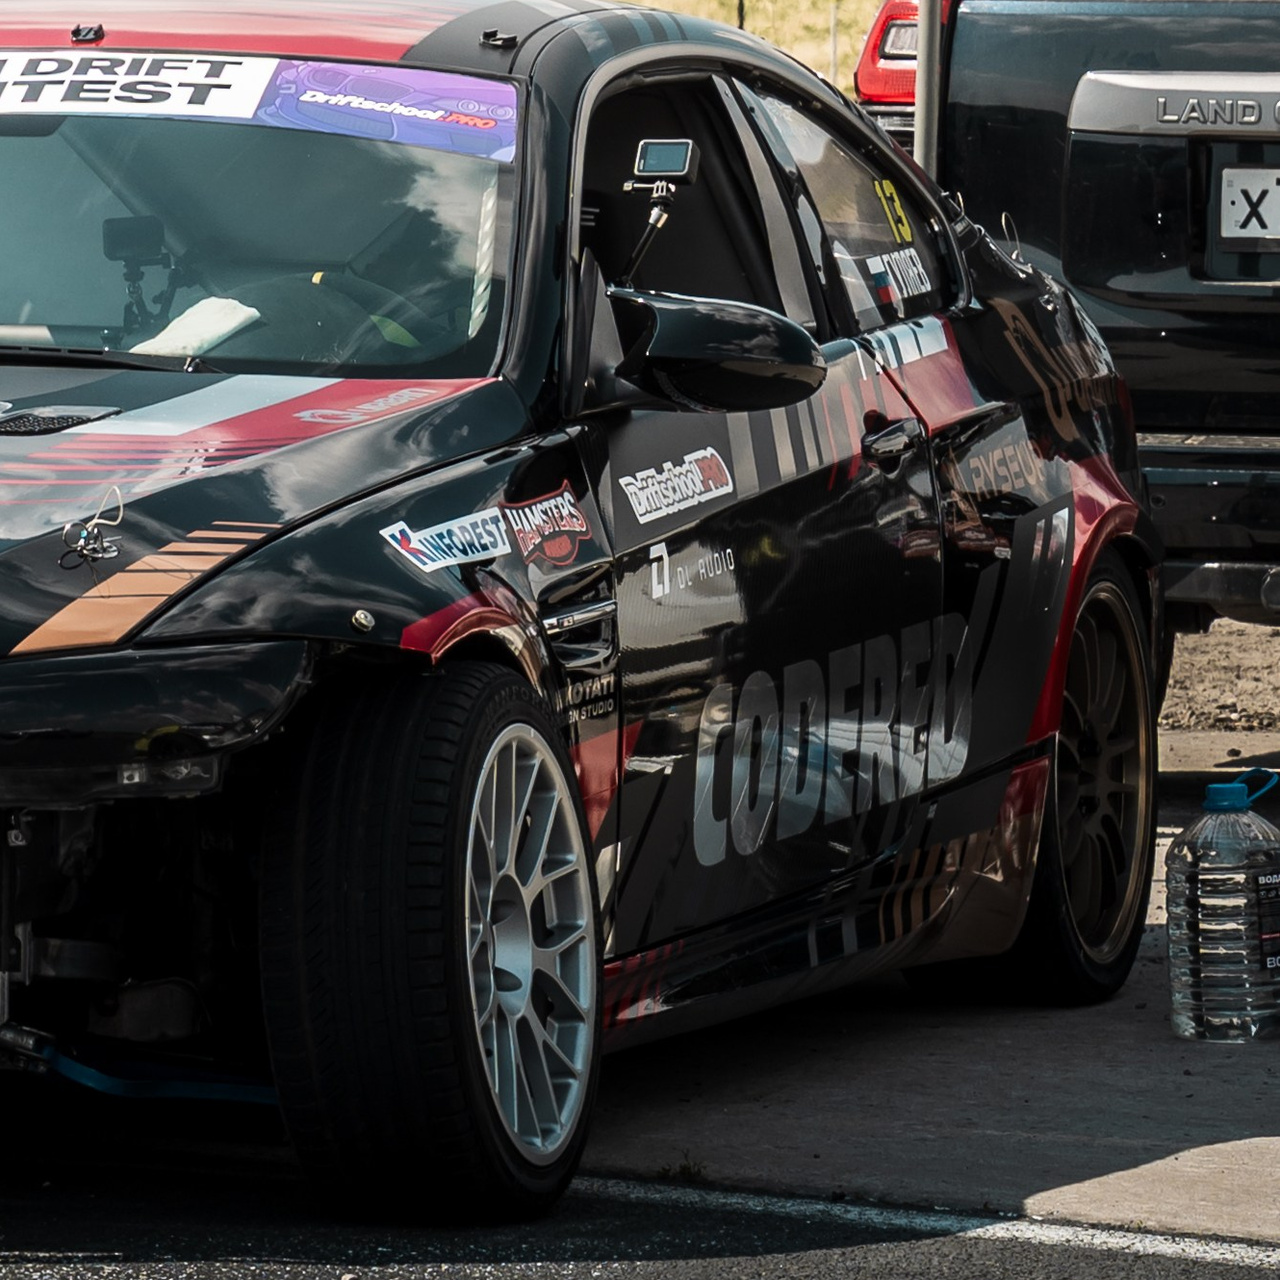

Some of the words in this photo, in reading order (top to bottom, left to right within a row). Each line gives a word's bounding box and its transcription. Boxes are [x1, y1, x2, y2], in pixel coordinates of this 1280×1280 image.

[20, 57, 243, 79] DRIFT
[1157, 97, 1262, 125] LAND
[874, 179, 913, 244] 13
[505, 491, 587, 556] HAMSTERS
[388, 514, 507, 567] KINFOREST
[698, 548, 735, 581] AUDIO
[580, 699, 615, 720] STUDIO
